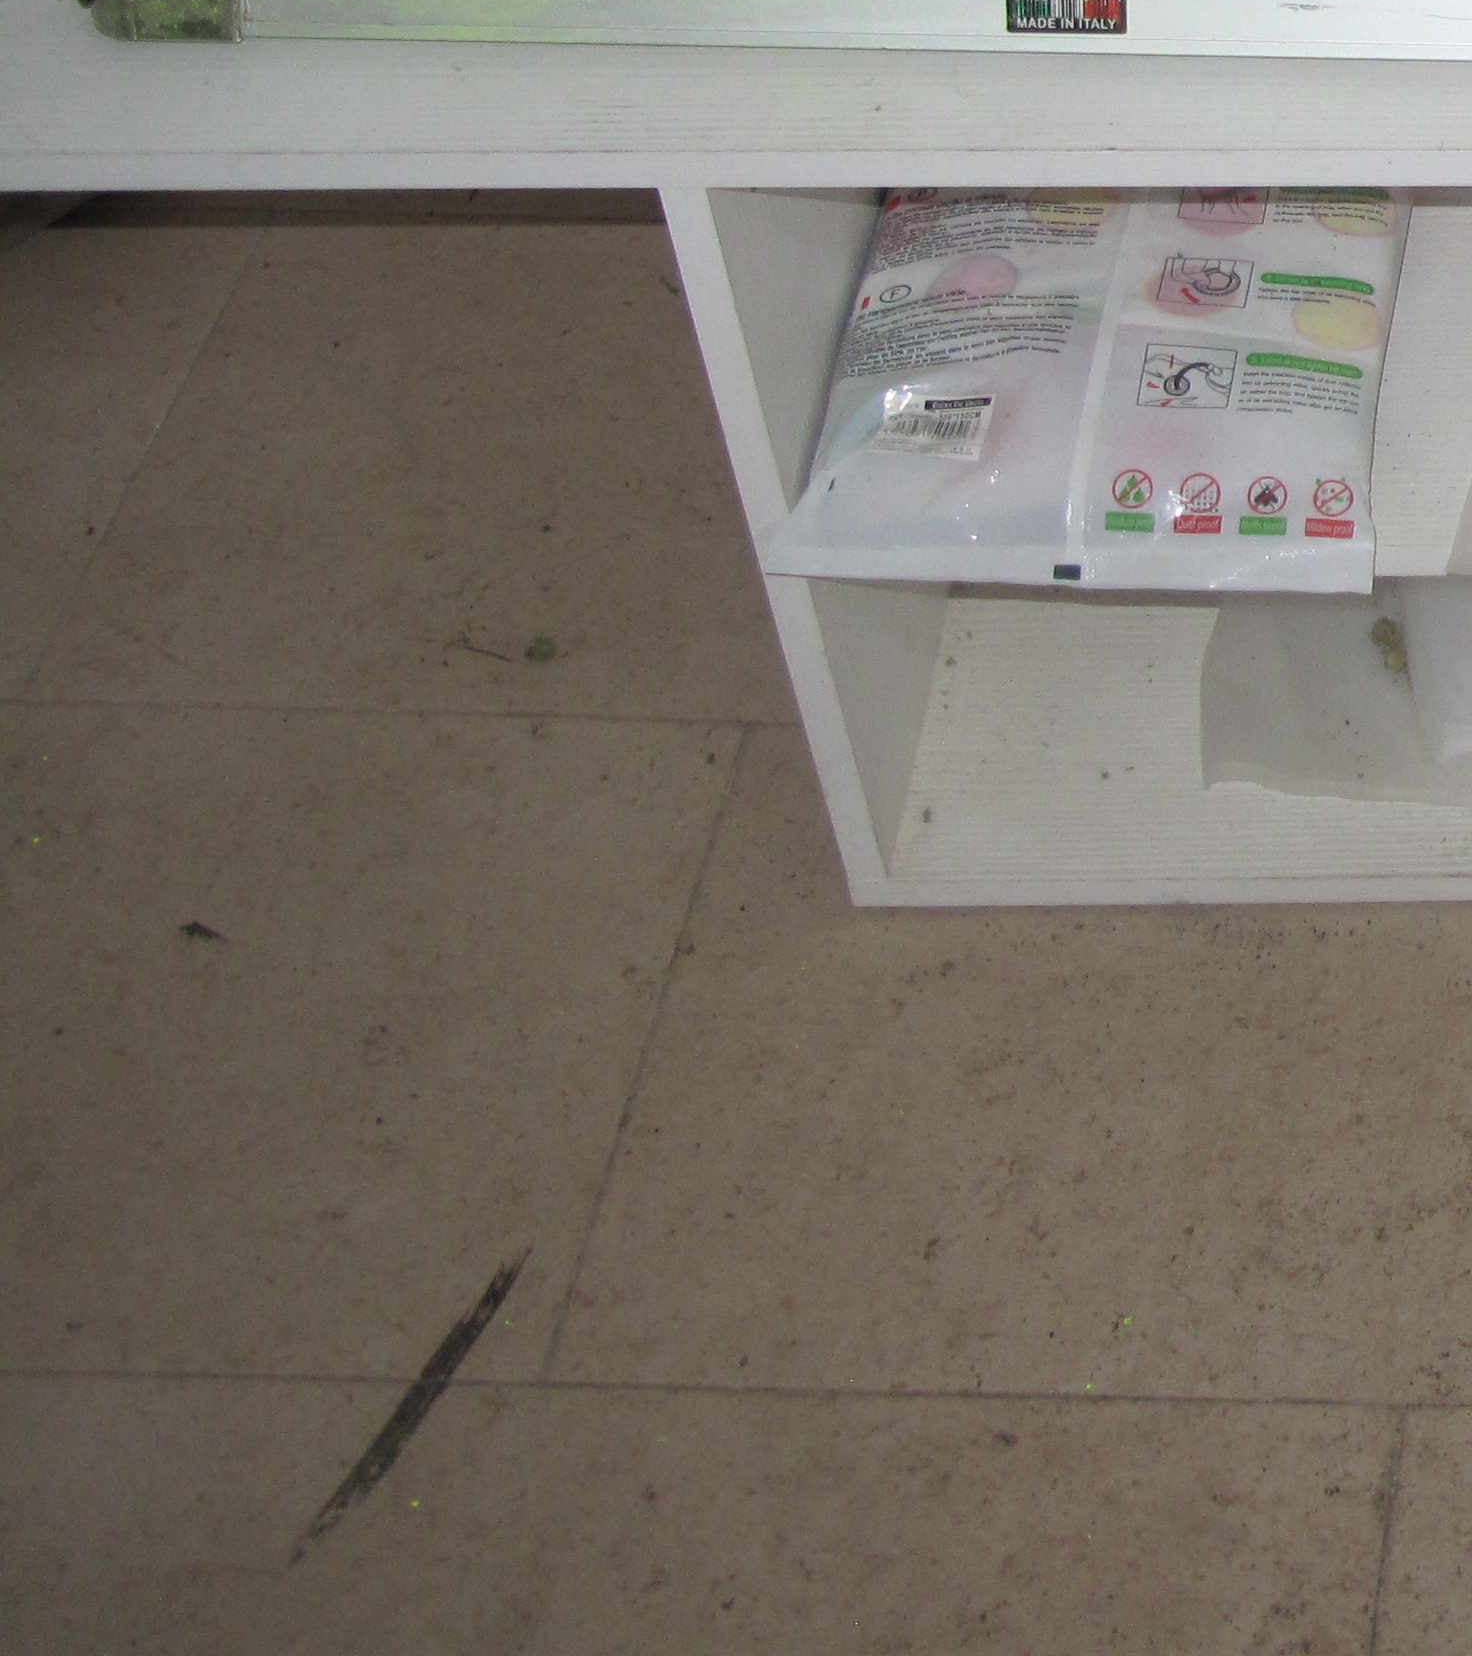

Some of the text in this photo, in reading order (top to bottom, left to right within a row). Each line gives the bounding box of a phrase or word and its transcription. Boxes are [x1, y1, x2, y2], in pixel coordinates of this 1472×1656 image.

[1016, 17, 1117, 30] MADE IN ITALY
